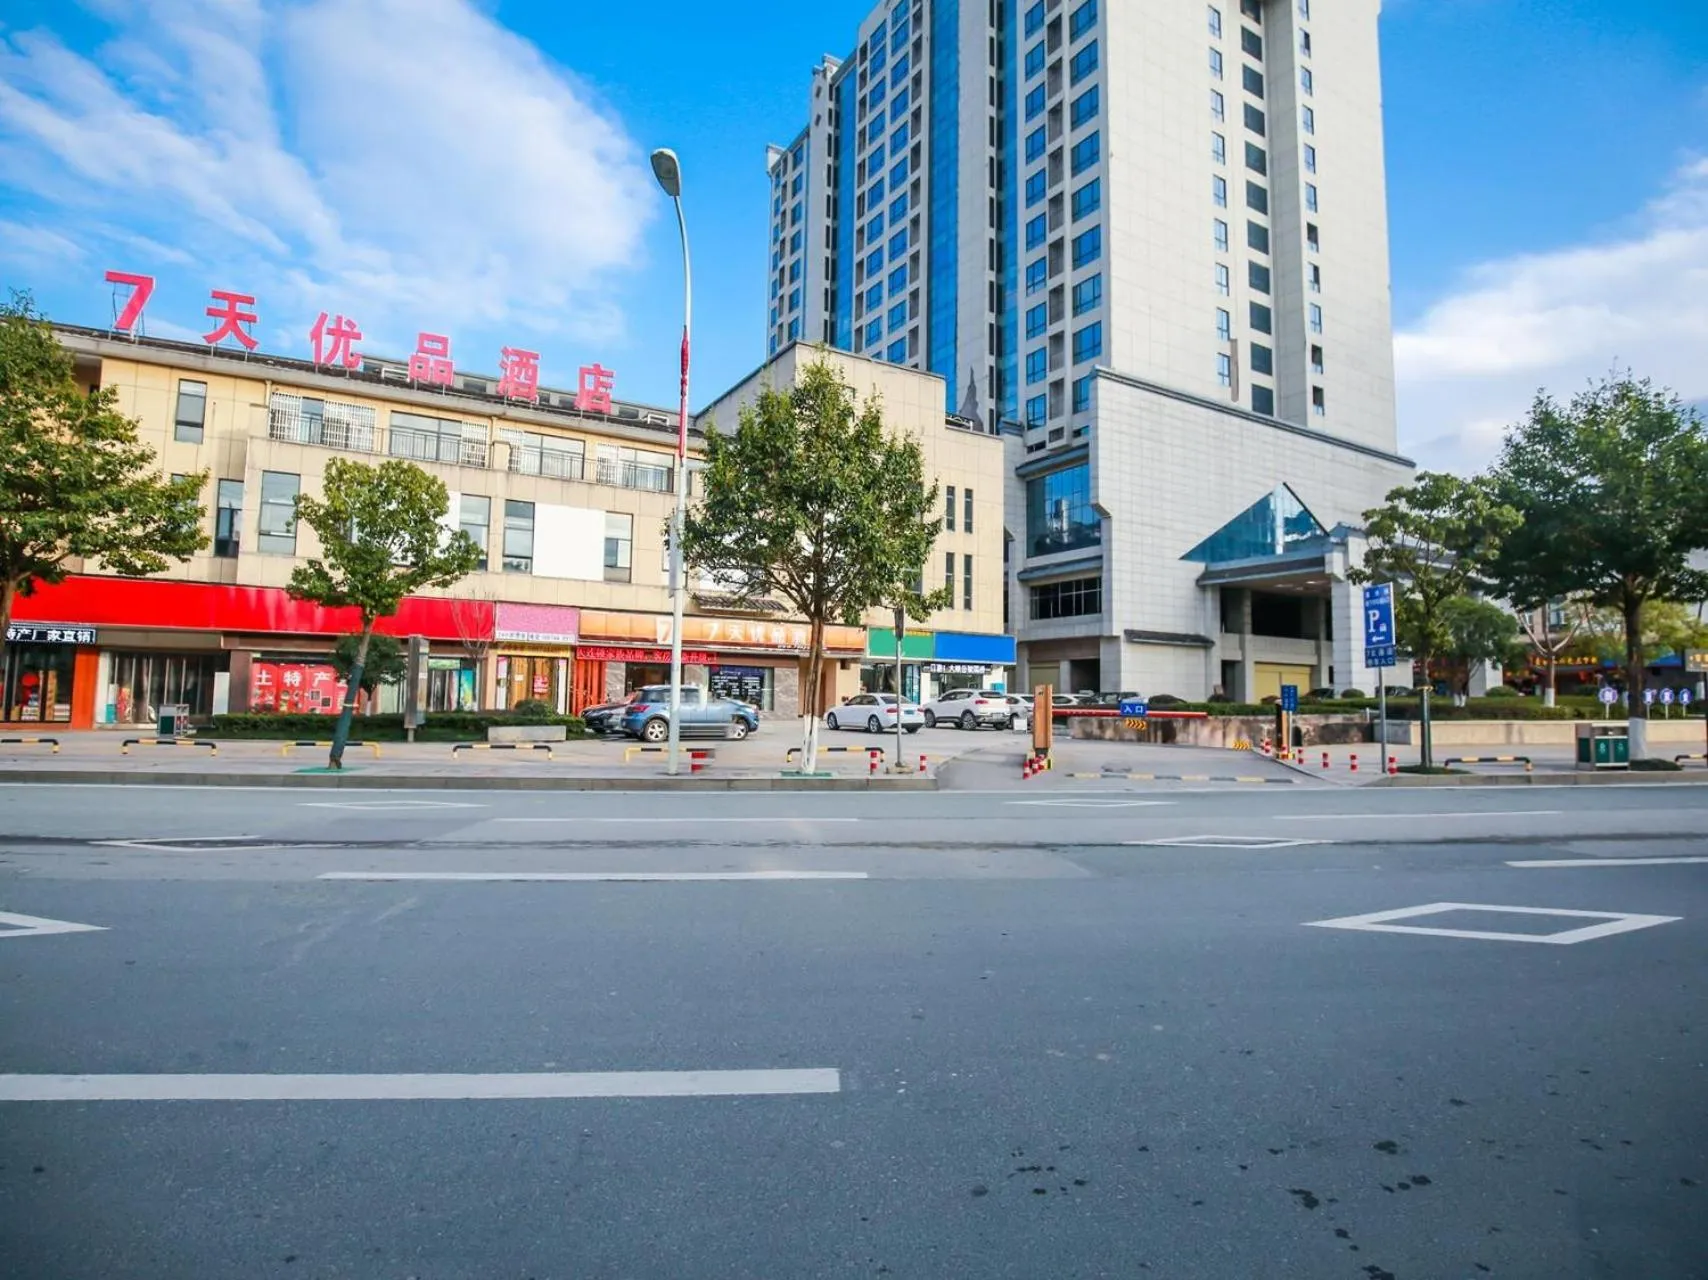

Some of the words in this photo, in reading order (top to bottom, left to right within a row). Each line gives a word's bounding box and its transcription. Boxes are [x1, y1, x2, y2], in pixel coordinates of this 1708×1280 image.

[104, 271, 616, 412] 7天优品酒店
[1368, 609, 1380, 633] P
[1124, 706, 1143, 714] 入口
